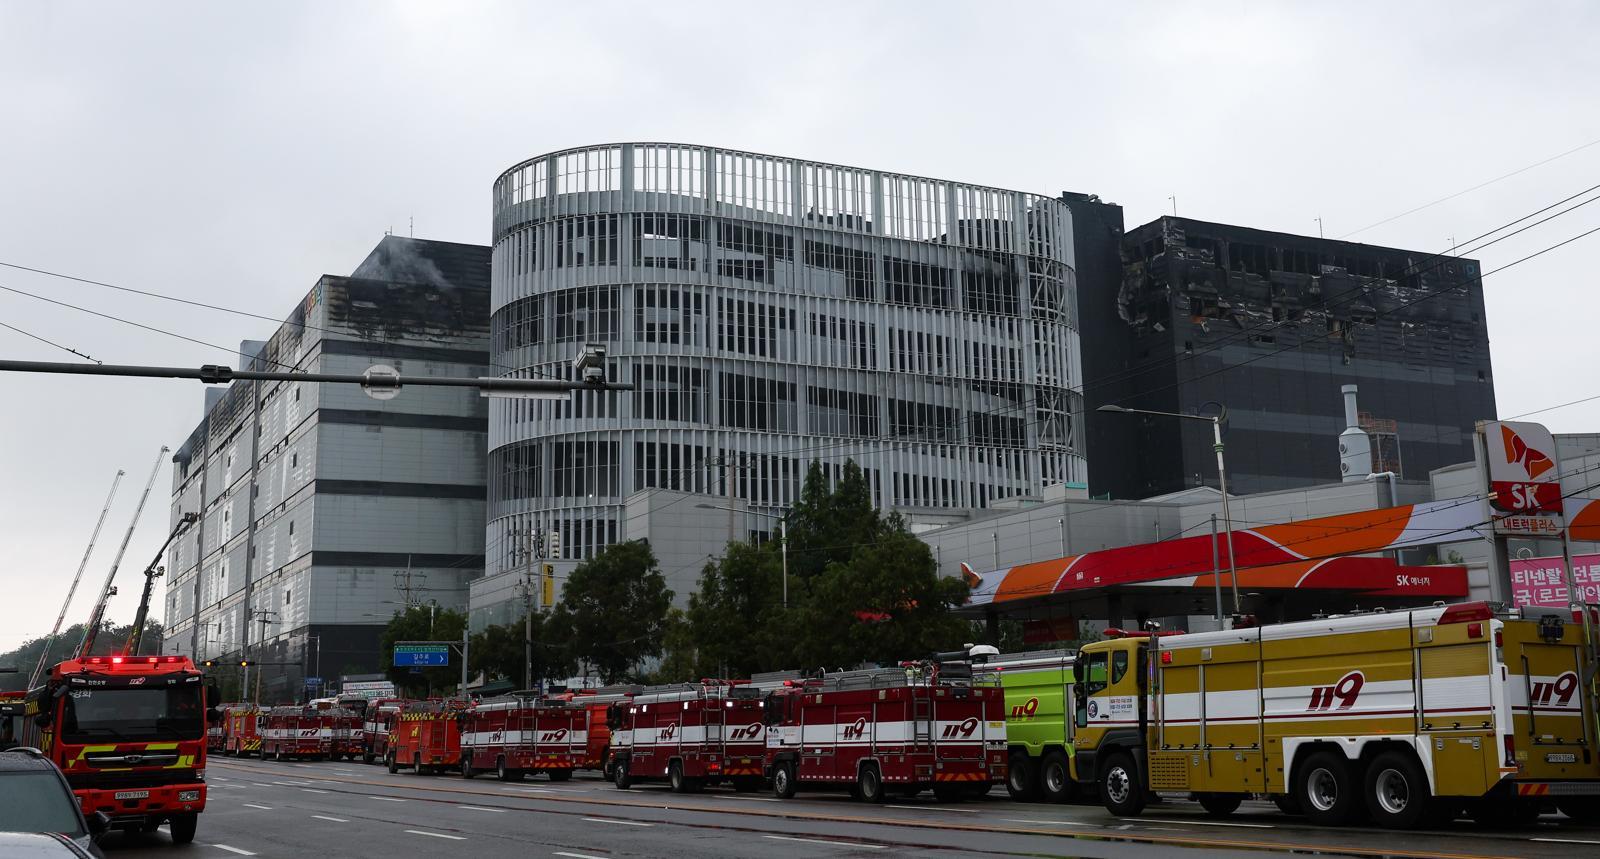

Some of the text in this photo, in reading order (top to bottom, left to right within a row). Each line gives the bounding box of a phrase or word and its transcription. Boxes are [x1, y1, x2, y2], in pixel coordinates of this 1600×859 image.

[1511, 483, 1541, 509] SK
[1503, 518, 1557, 532] 내트럭플러스
[1396, 574, 1431, 586] SK 에너지
[1511, 568, 1562, 586] 티넨탈
[1512, 588, 1568, 607] 국(로드
[1307, 671, 1365, 711] 119
[1530, 672, 1578, 706] 119
[1011, 697, 1039, 718] 119
[541, 729, 567, 742] 119
[660, 723, 675, 740] 119
[730, 722, 762, 739] 119
[843, 717, 866, 739] 119
[942, 717, 978, 738] 119
